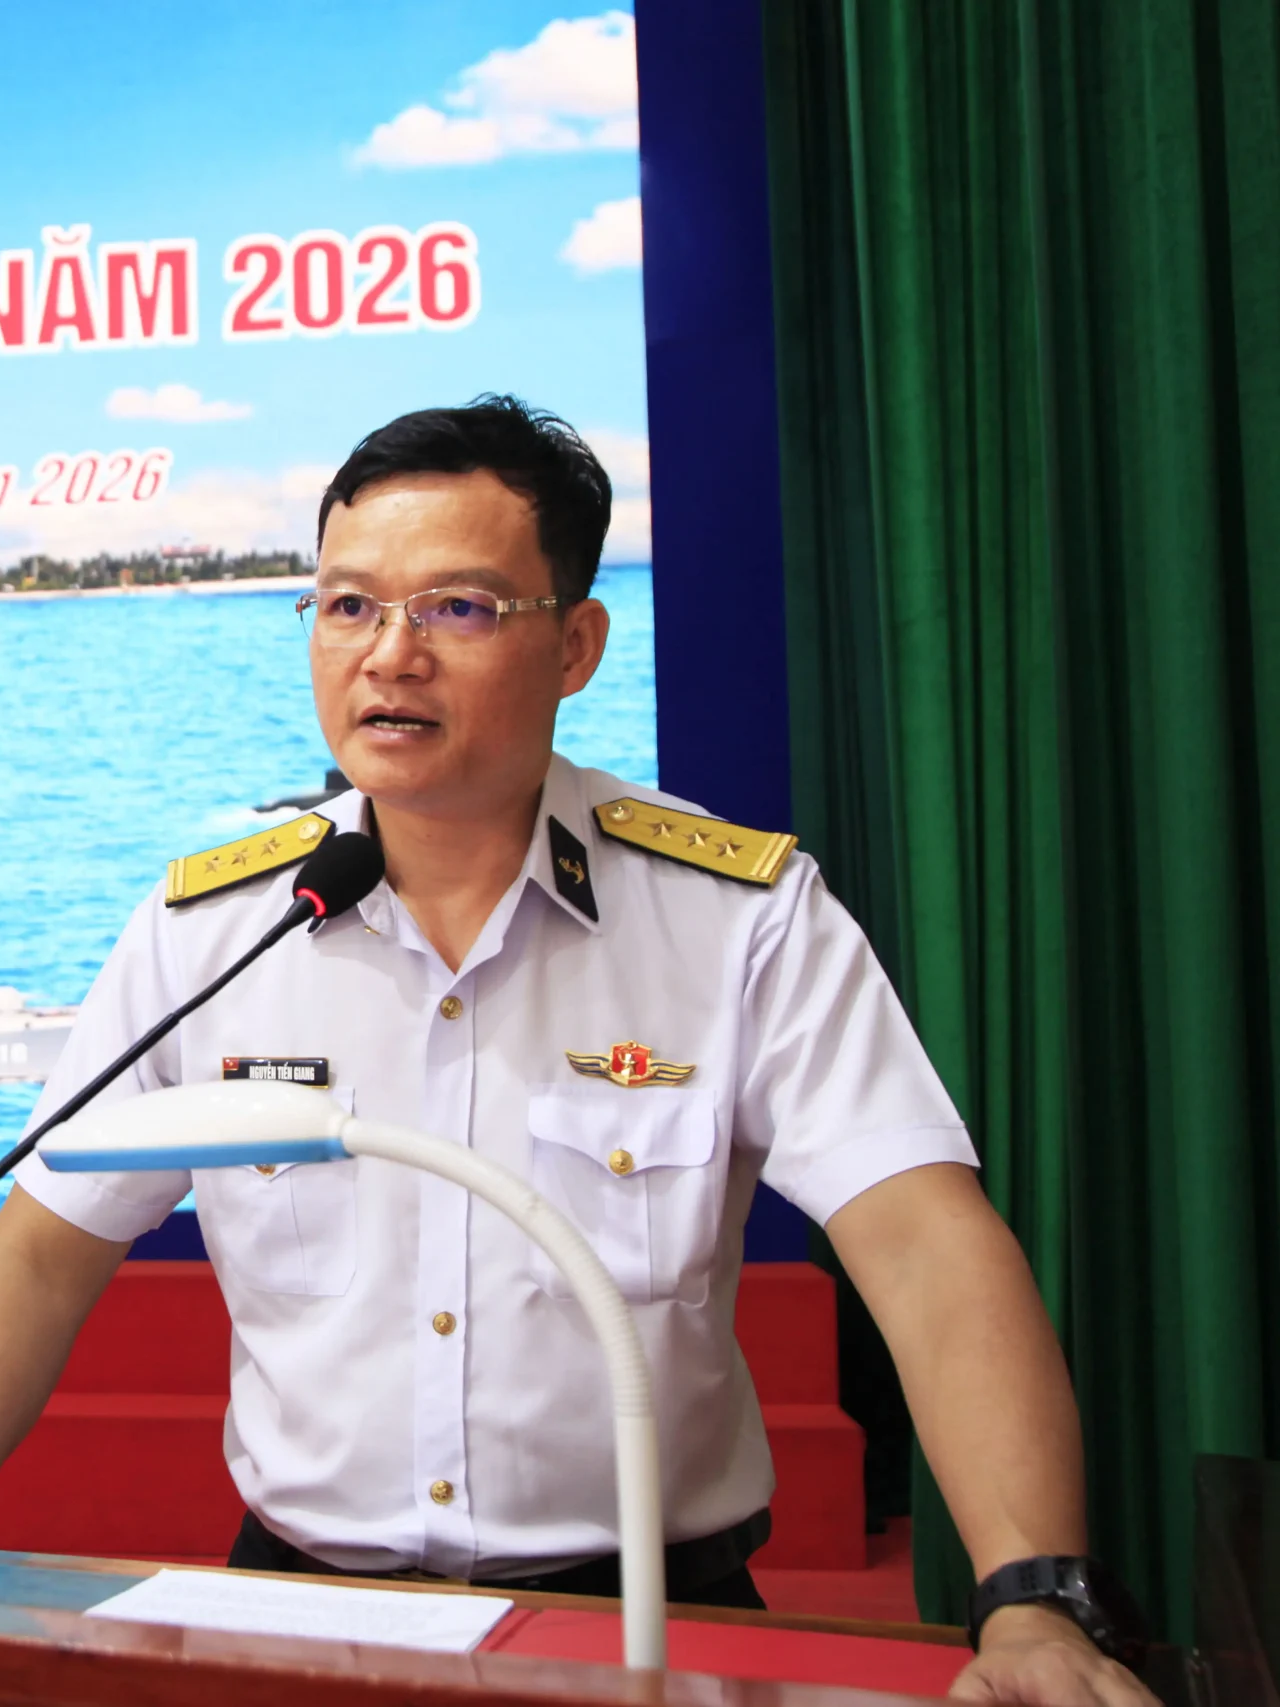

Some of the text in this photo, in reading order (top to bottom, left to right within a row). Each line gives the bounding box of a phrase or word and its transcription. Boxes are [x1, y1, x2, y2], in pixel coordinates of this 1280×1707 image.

[229, 229, 474, 336] 2026
[27, 451, 169, 509] 2026
[293, 1065, 316, 1082] GIANG
